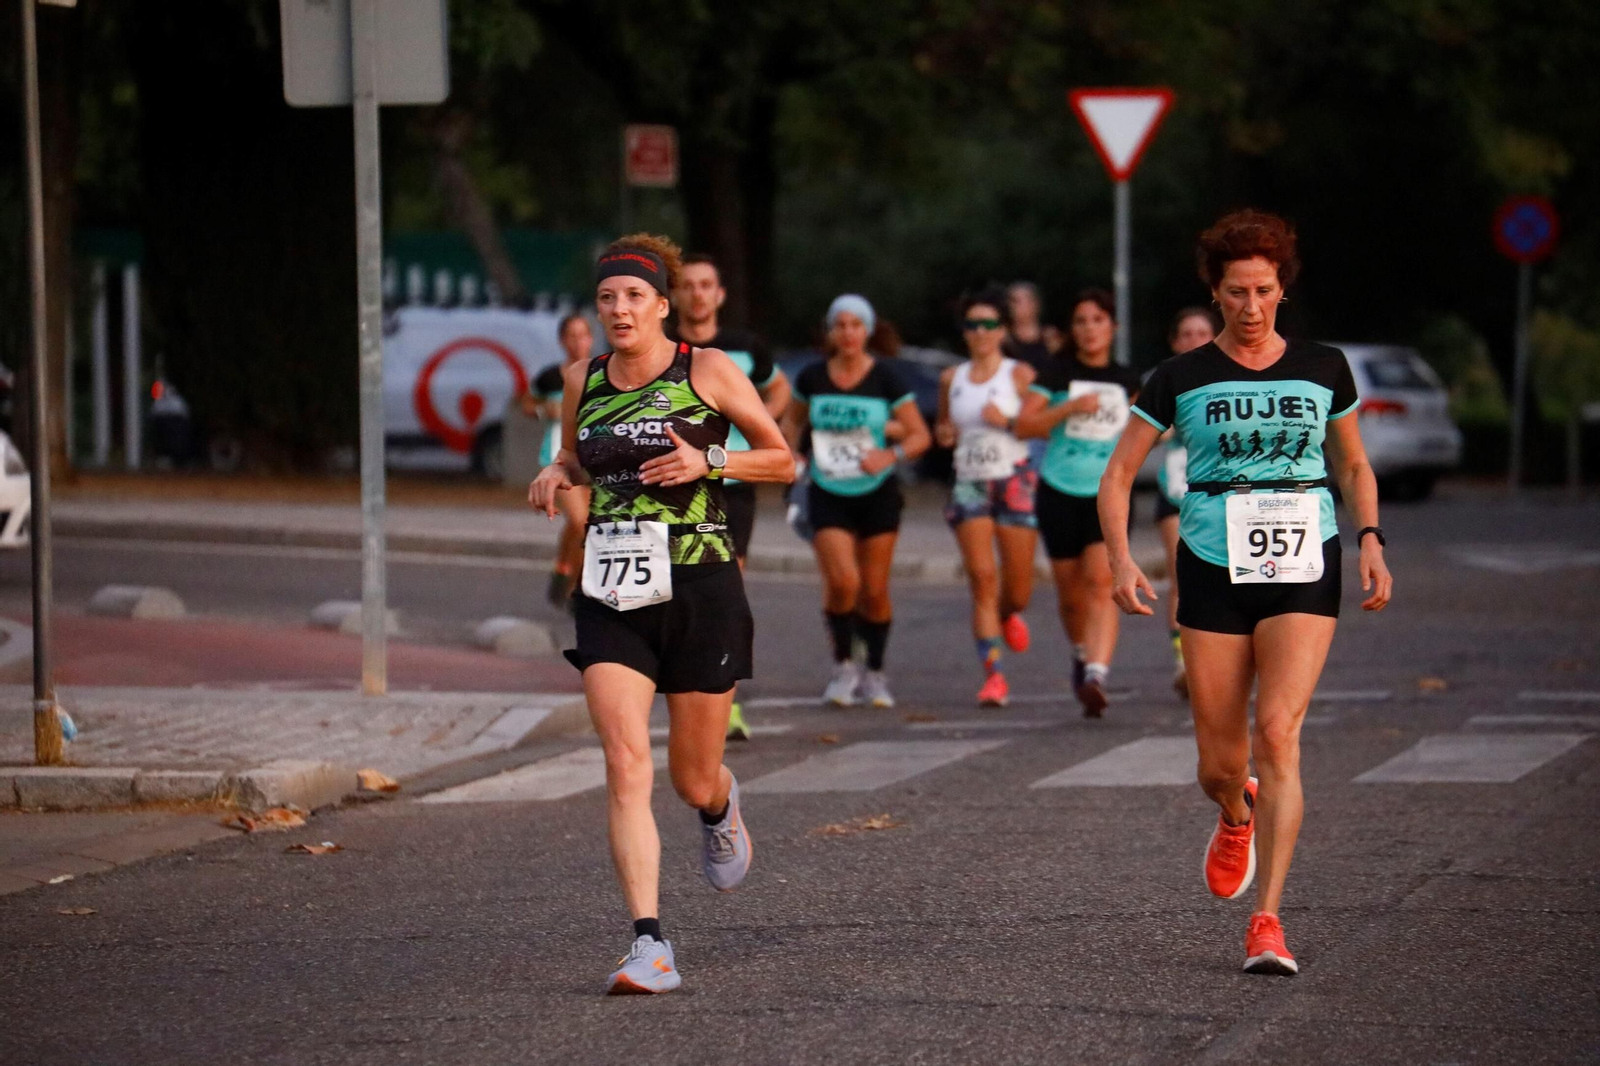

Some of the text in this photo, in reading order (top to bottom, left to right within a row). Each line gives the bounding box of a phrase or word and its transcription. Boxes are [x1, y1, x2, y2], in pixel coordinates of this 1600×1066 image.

[1206, 396, 1318, 425] MUJER
[632, 437, 675, 447] TRAIL
[595, 469, 640, 486] DINÁM
[1248, 528, 1306, 558] 957
[598, 556, 652, 587] 775
